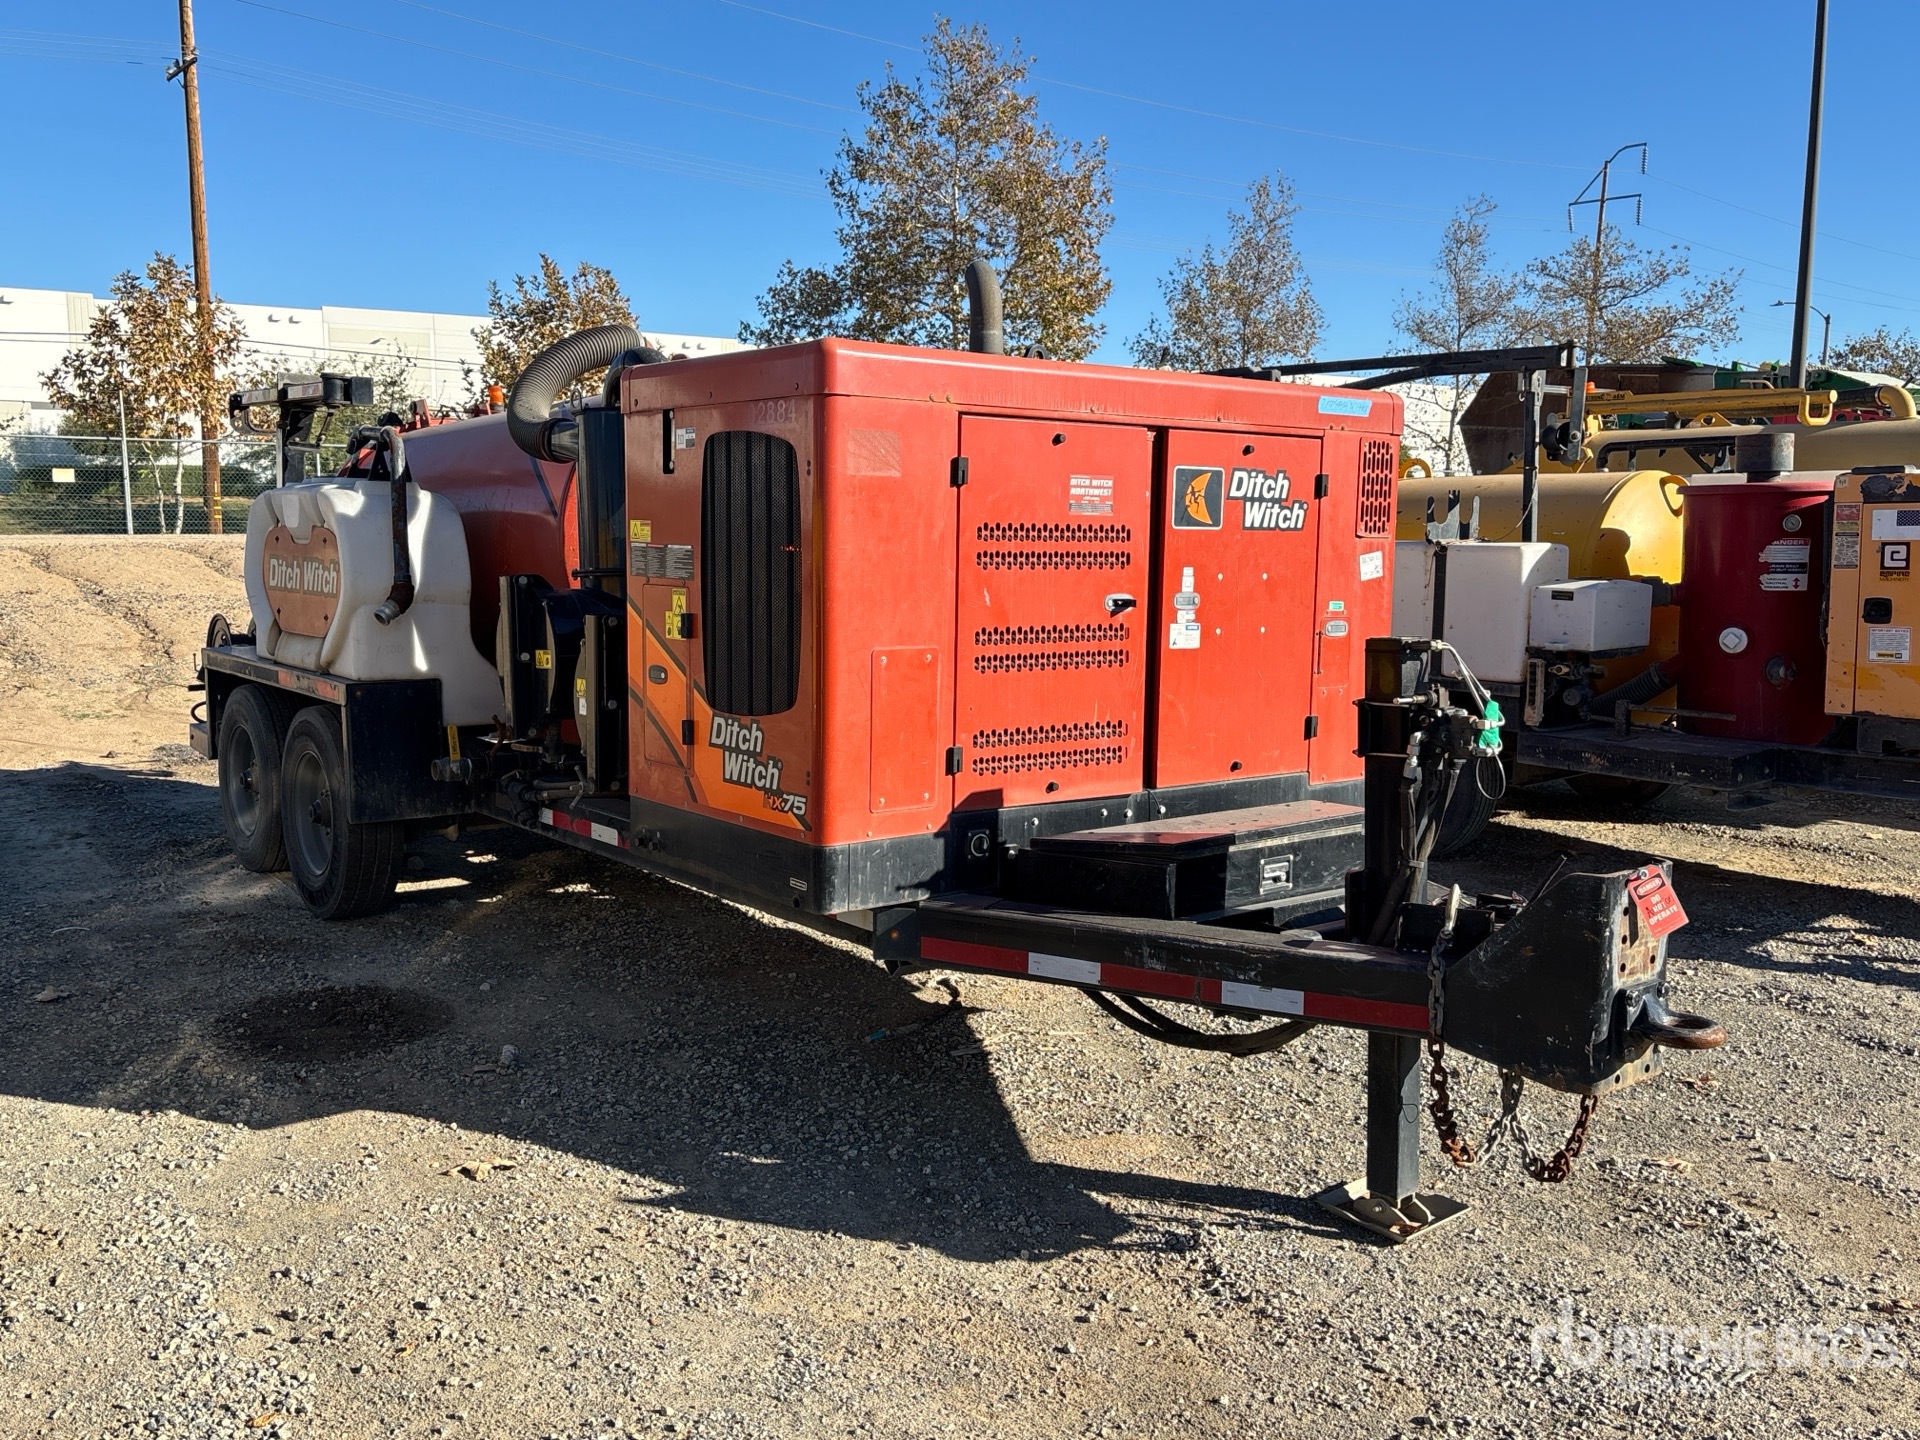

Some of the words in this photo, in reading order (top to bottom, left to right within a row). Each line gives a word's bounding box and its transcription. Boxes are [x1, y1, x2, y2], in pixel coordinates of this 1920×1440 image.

[1070, 478, 1090, 486] DITCH
[1091, 479, 1113, 487] WITCH
[1070, 487, 1111, 496] NORTHWEST
[1229, 470, 1290, 499] Ditch
[1244, 501, 1306, 529] Witch
[269, 558, 300, 590] Ditch
[303, 561, 338, 594] Witch
[710, 716, 763, 753] Ditch
[724, 751, 780, 790] Witch
[1650, 894, 1661, 905] DO
[1652, 902, 1667, 913] NOT
[1648, 905, 1679, 925] OPERATE
